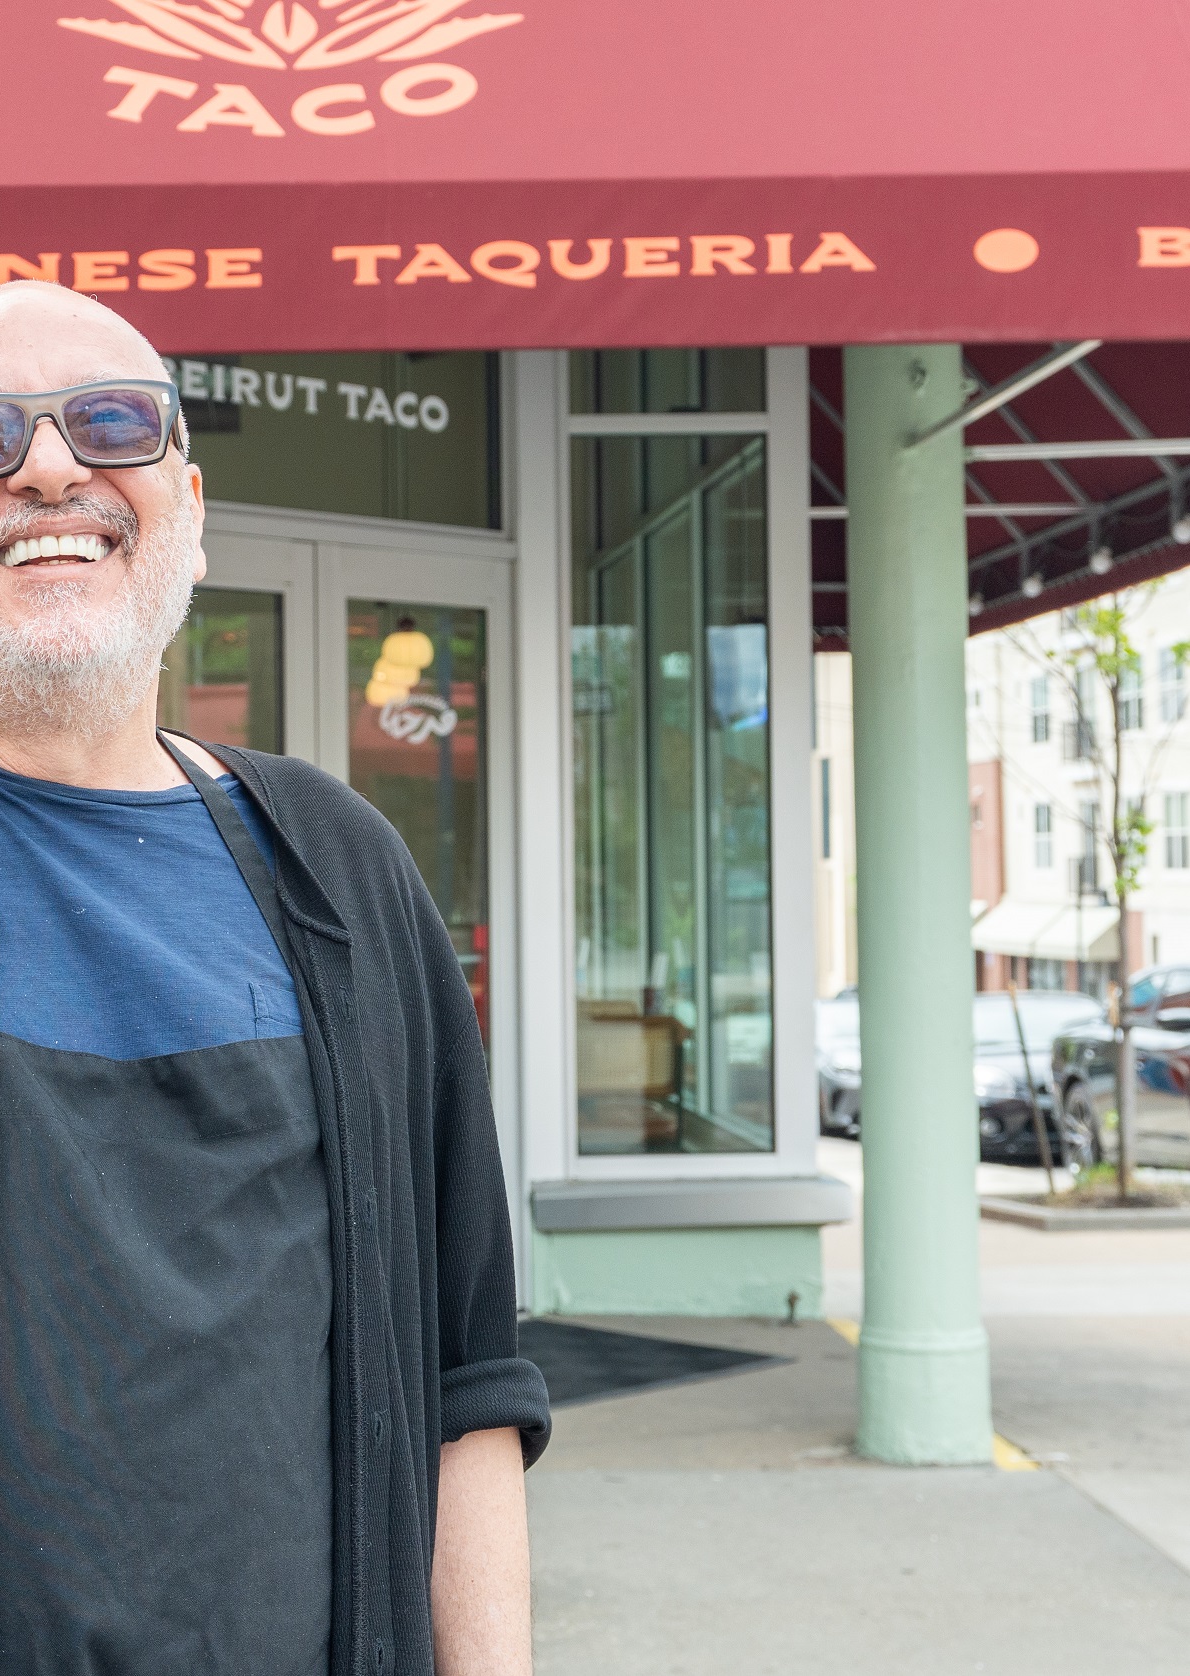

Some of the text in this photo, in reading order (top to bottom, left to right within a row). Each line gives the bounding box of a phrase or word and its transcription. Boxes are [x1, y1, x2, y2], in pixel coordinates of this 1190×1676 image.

[103, 62, 479, 138] TACO
[331, 231, 877, 289] TAQUERIA
[336, 381, 450, 433] TACO
